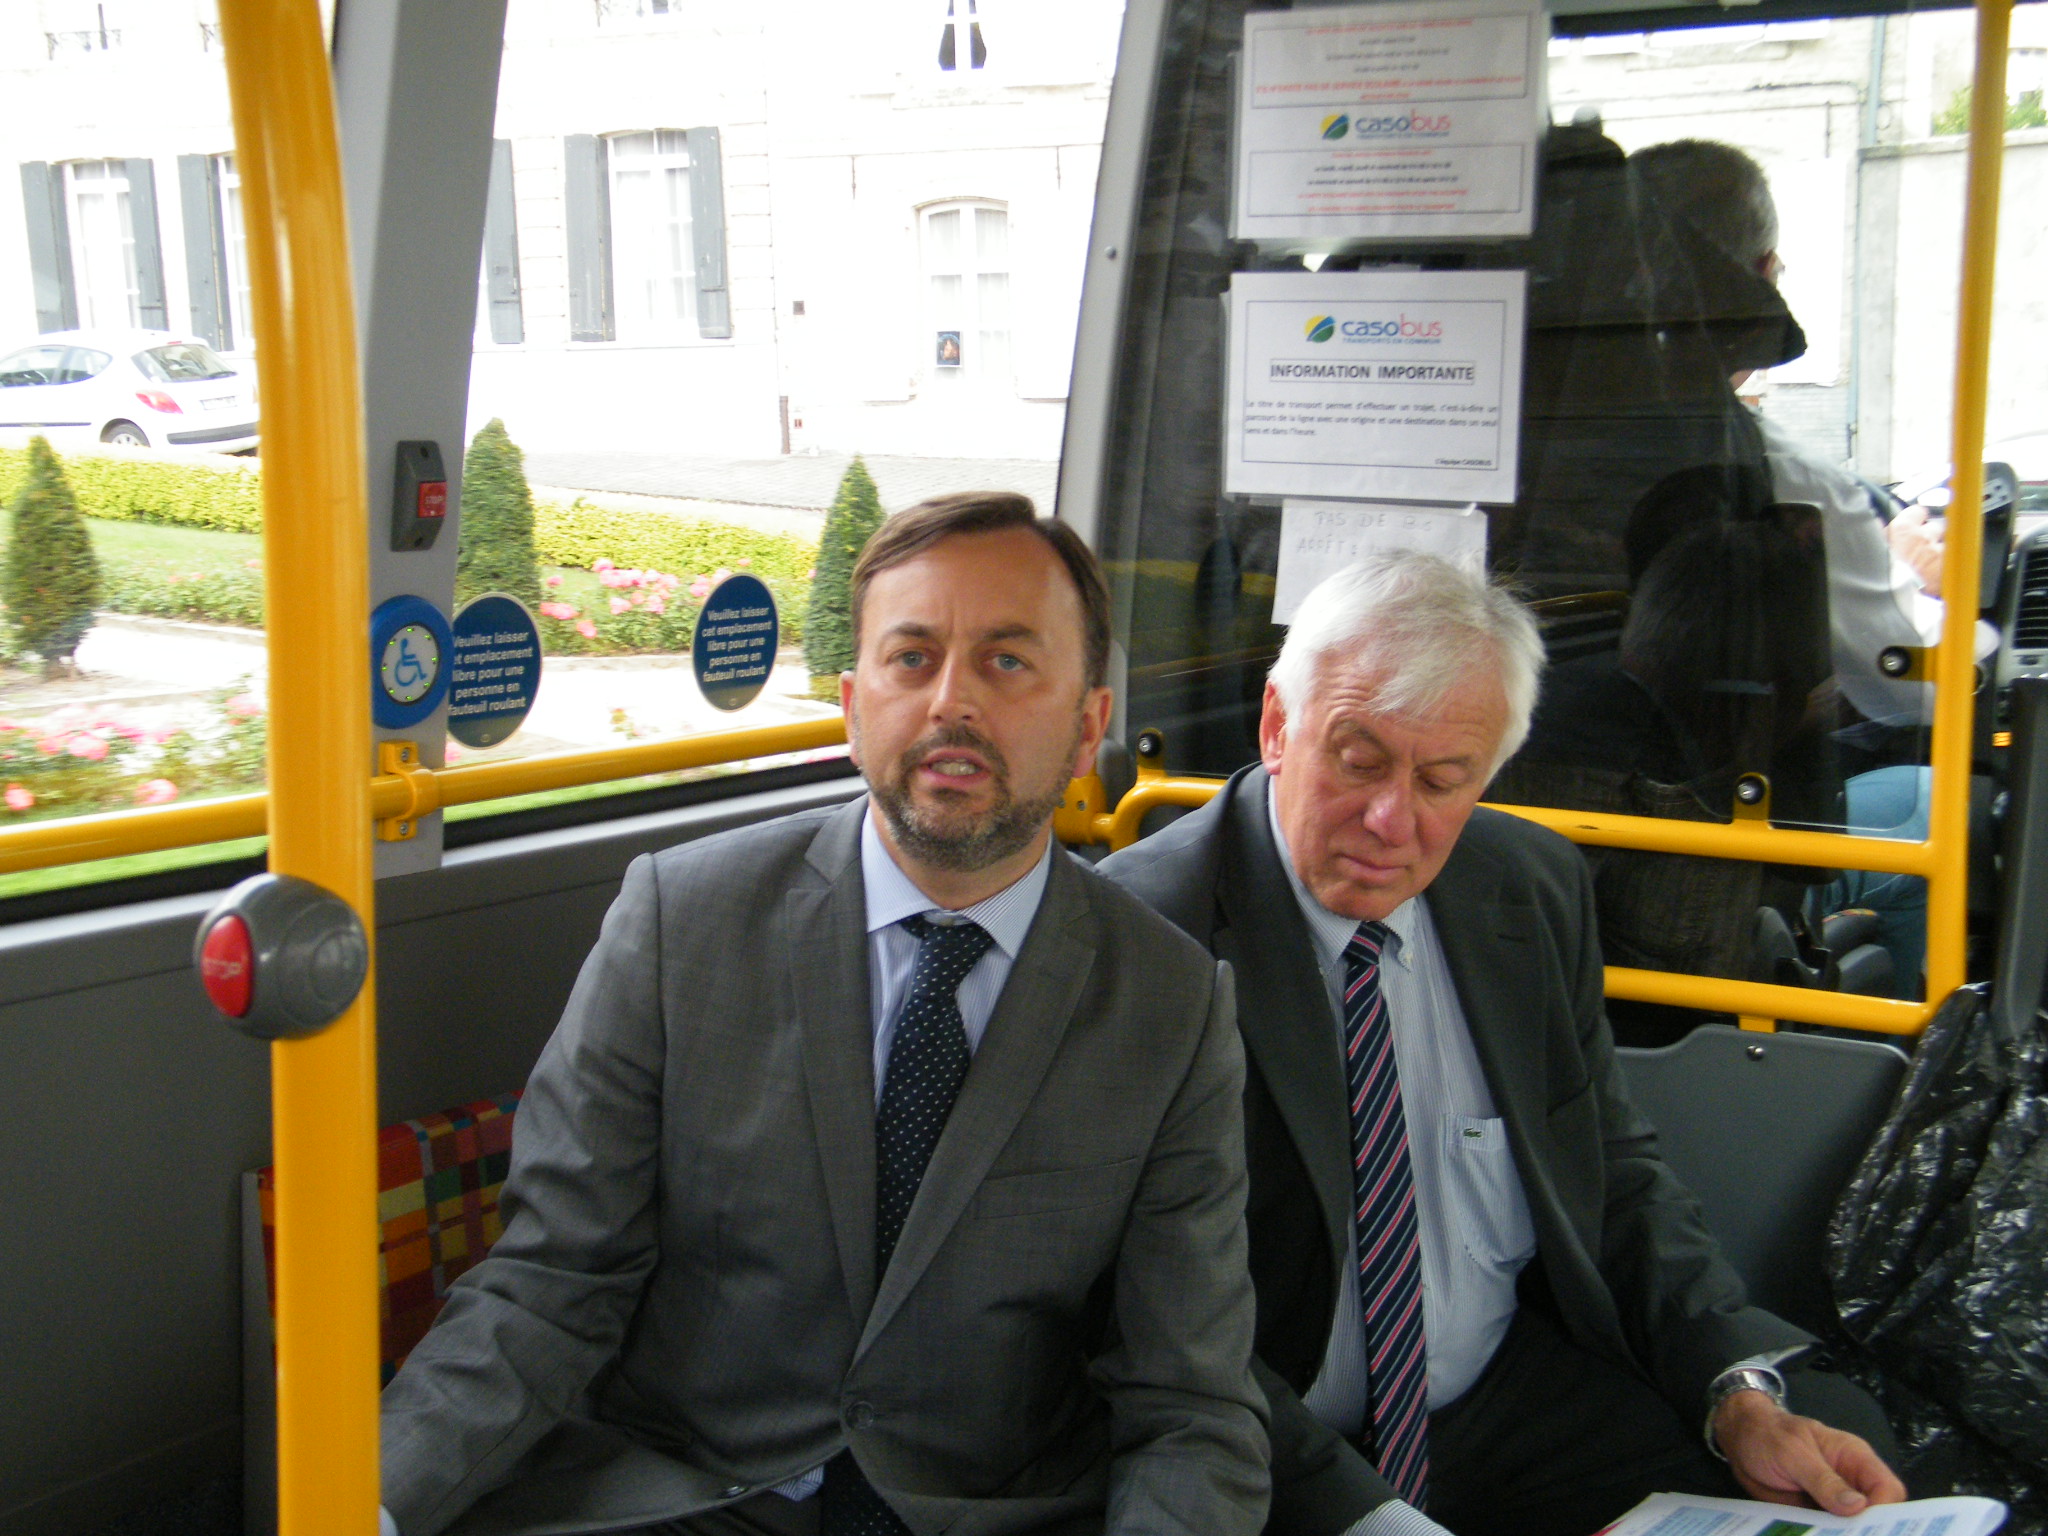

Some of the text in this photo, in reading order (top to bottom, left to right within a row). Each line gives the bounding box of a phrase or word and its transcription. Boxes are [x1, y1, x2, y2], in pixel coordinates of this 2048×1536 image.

[1355, 107, 1452, 133] casobus
[1341, 313, 1443, 337] casobus
[1269, 364, 1475, 380] INFORMATION IMPORTANTE
[707, 606, 770, 621] Veuillez laisser
[494, 631, 530, 644] laisser
[701, 620, 773, 638] cet emplacement
[707, 637, 766, 652] libre pour une
[463, 646, 533, 665] emplacement
[709, 652, 762, 669] personne en
[452, 665, 525, 683] libre pour une
[703, 665, 767, 682] fauteuil roulant
[455, 682, 520, 701] personne en
[489, 696, 527, 712] roulant
